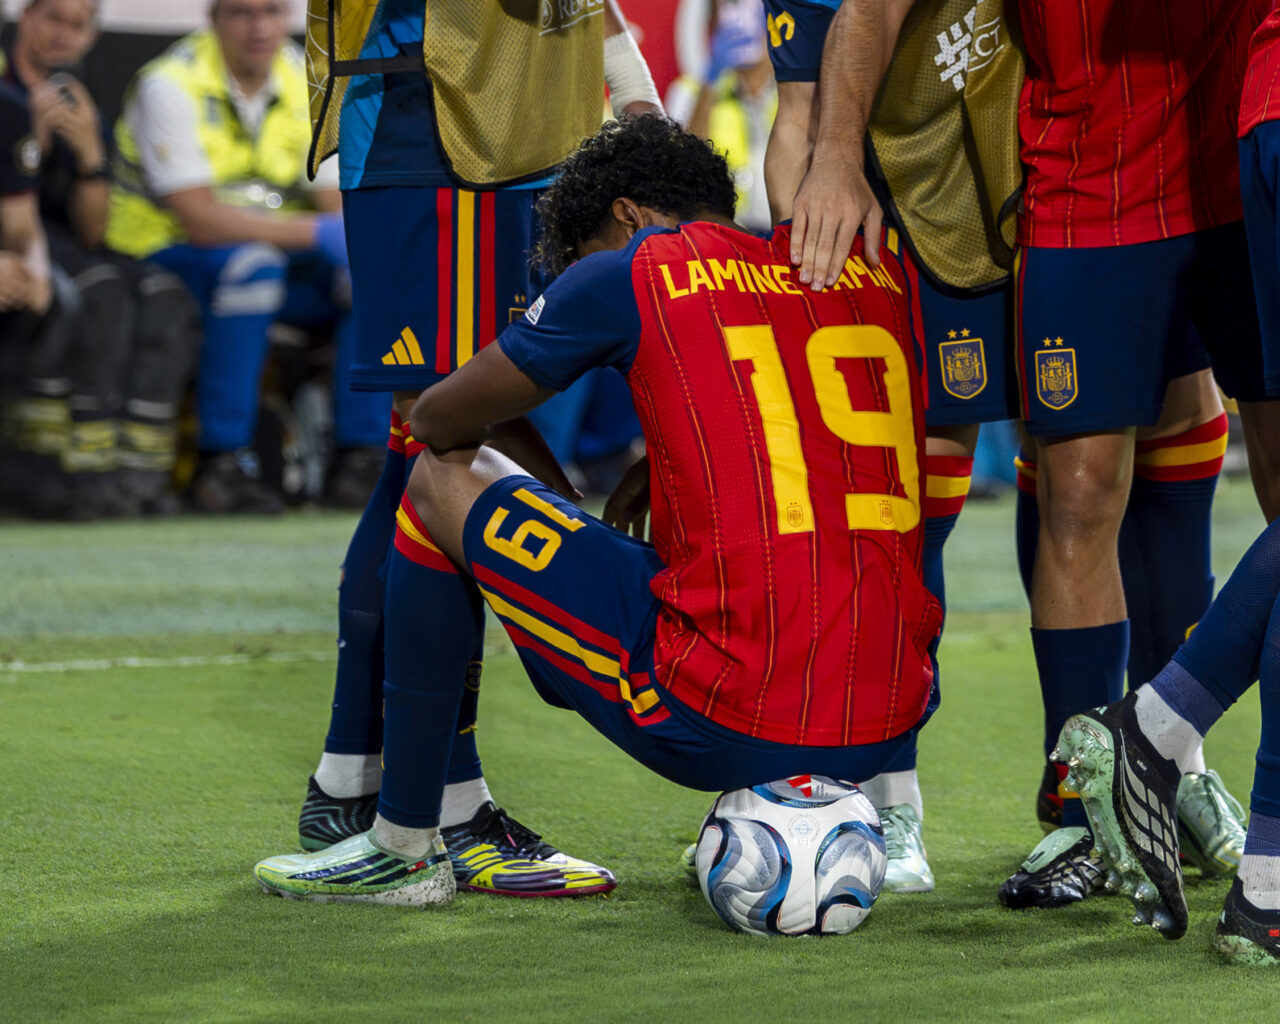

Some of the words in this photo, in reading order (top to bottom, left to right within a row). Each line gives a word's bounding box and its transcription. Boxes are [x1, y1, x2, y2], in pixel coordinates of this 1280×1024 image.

[659, 258, 803, 299] LAMINE
[723, 324, 920, 535] 19
[483, 488, 587, 572] 19
